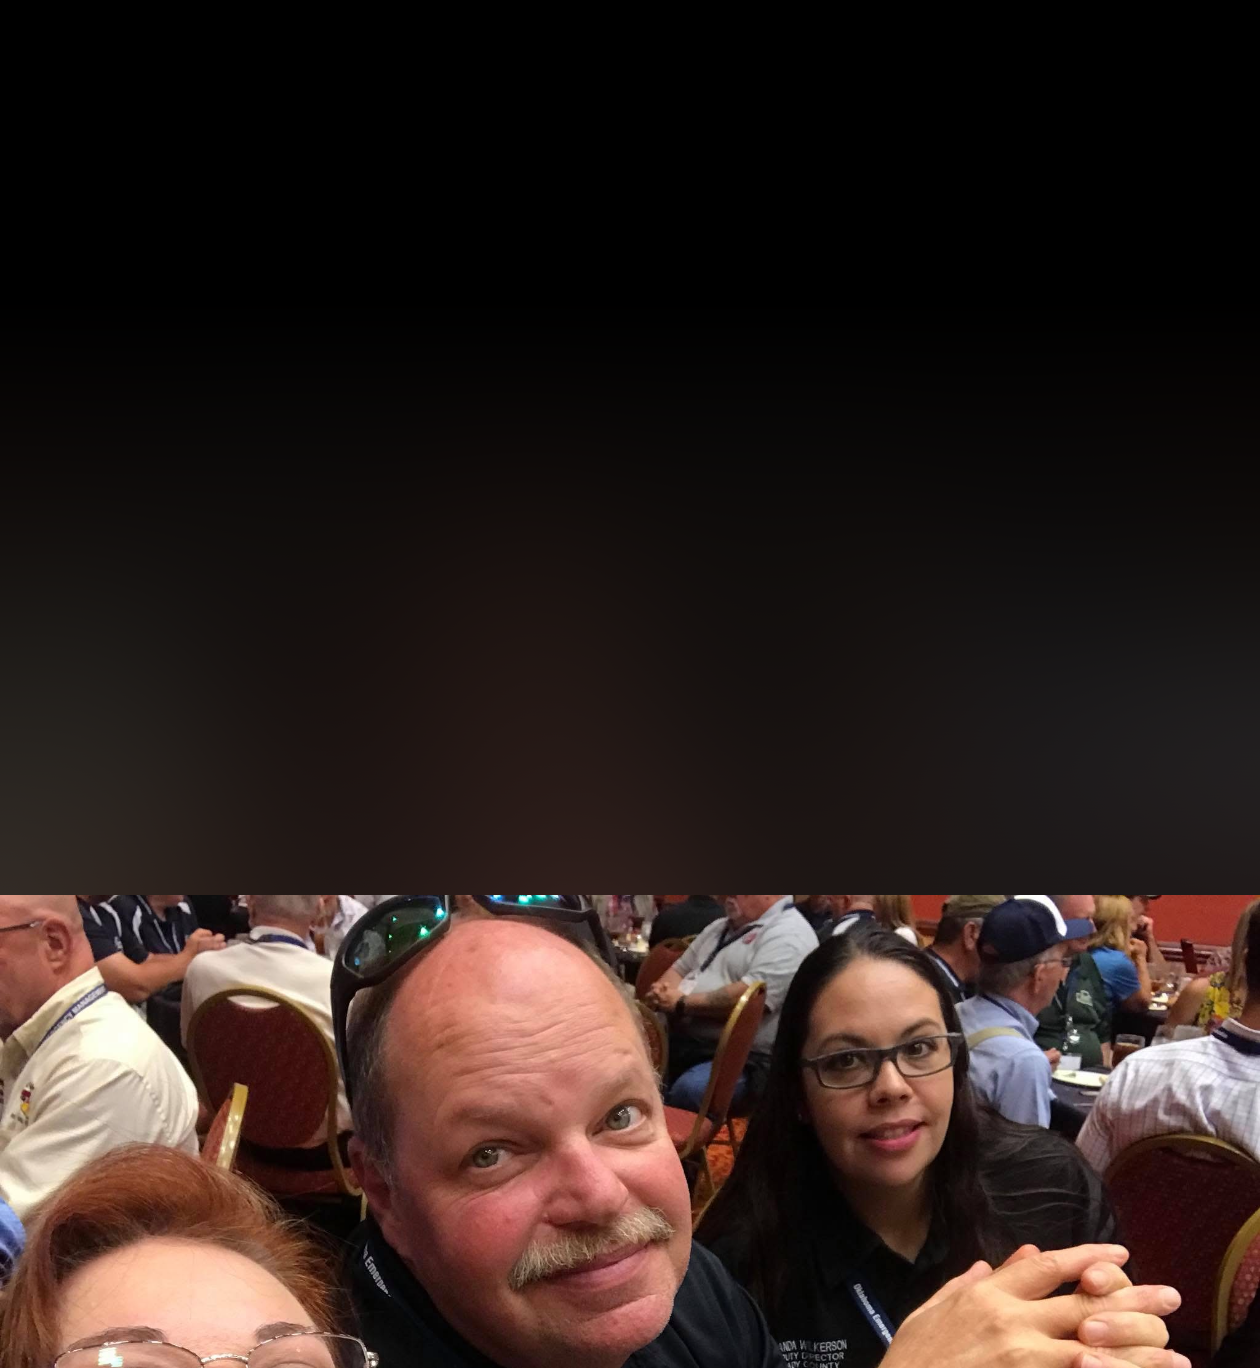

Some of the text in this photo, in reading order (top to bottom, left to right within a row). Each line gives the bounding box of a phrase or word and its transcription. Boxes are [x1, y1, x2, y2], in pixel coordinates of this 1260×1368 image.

[853, 1283, 875, 1315] Oklahoma
[800, 1339, 848, 1352] WKERSON
[801, 1351, 845, 1361] DRECTOR
